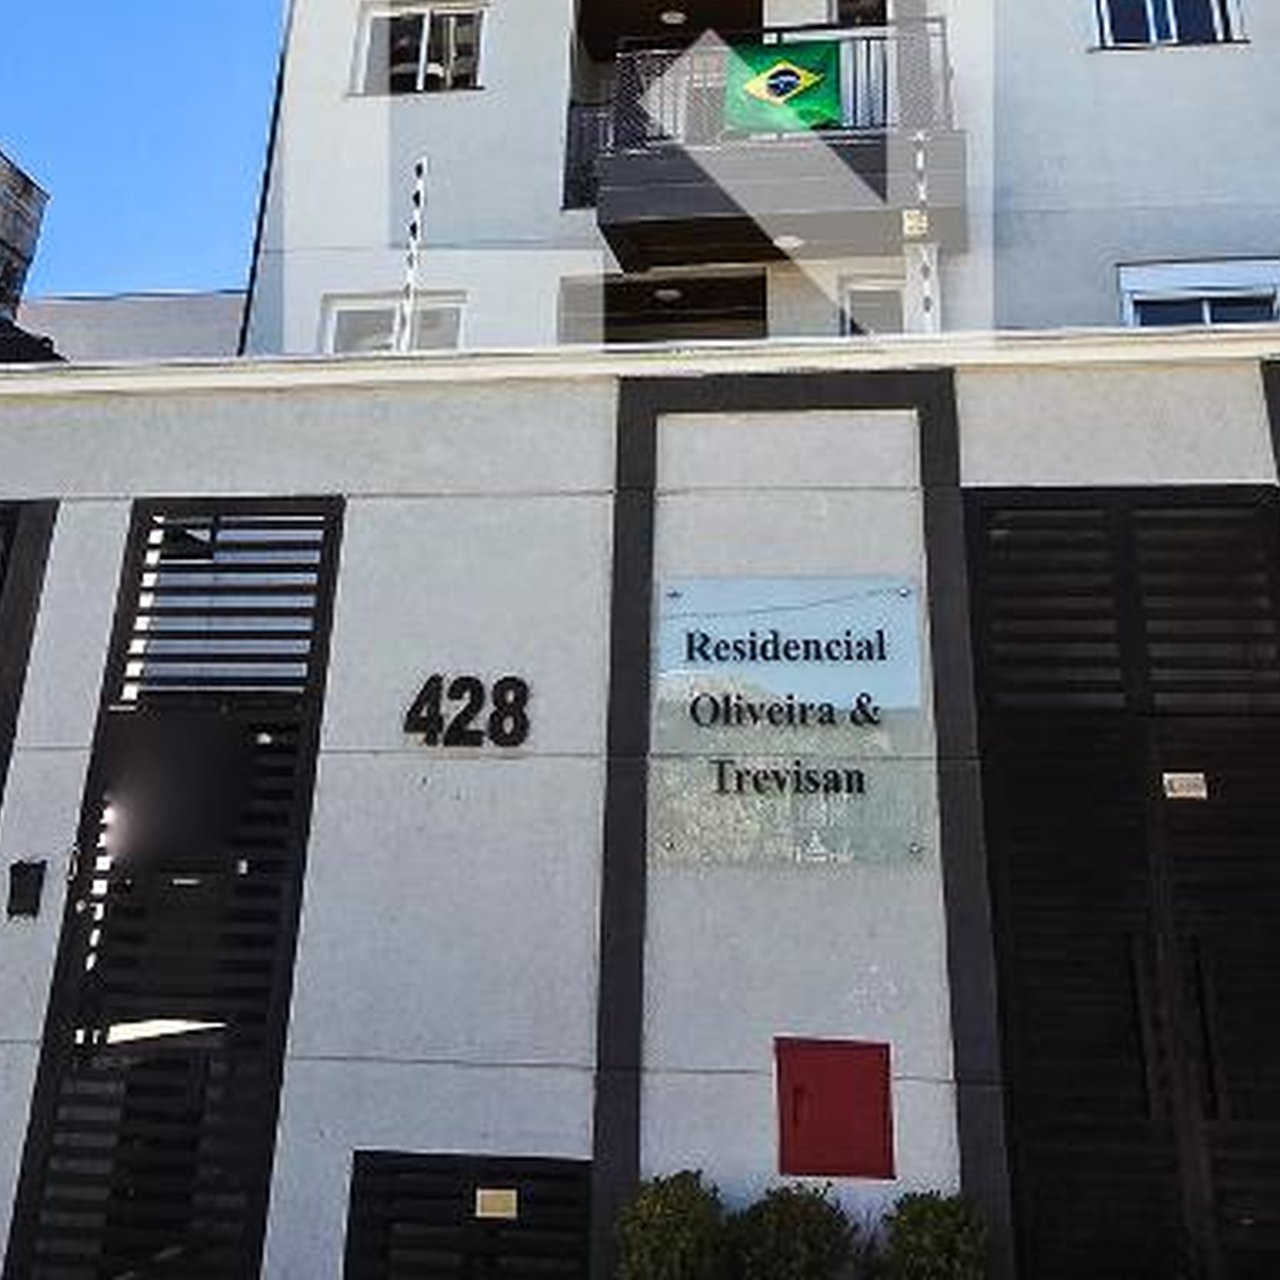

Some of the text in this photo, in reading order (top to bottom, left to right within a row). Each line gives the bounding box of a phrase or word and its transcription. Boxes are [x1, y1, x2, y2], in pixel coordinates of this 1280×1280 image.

[686, 629, 888, 662] Residencial
[402, 673, 531, 747] 428
[689, 692, 882, 728] Oliveira &
[709, 759, 866, 795] Trevisan
